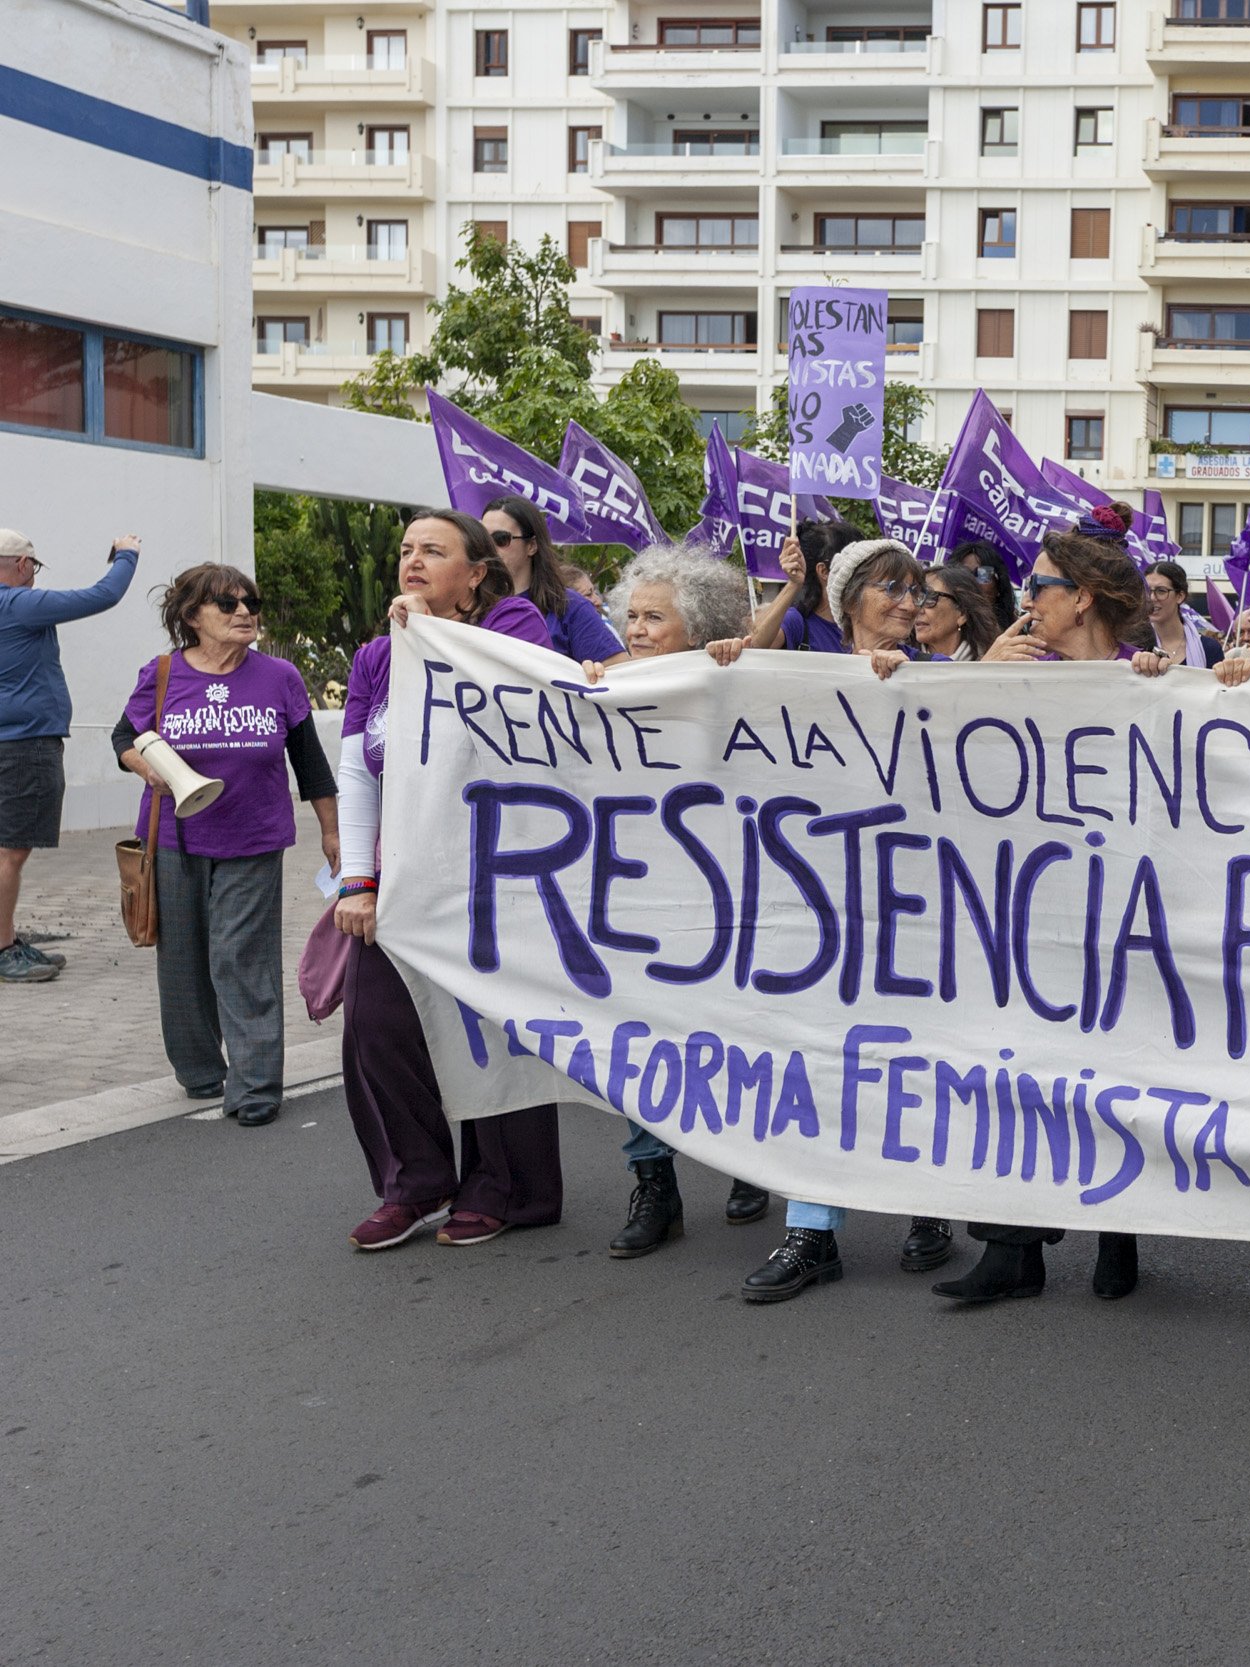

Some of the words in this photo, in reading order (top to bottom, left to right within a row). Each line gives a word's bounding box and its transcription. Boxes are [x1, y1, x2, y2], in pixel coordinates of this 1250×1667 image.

[790, 298, 885, 335] OLESTAN
[1191, 466, 1241, 477] GRADUADOS
[1198, 455, 1238, 467] ASESORIA
[420, 658, 682, 772] FRENTE
[722, 717, 777, 766] A
[780, 705, 847, 768] LA
